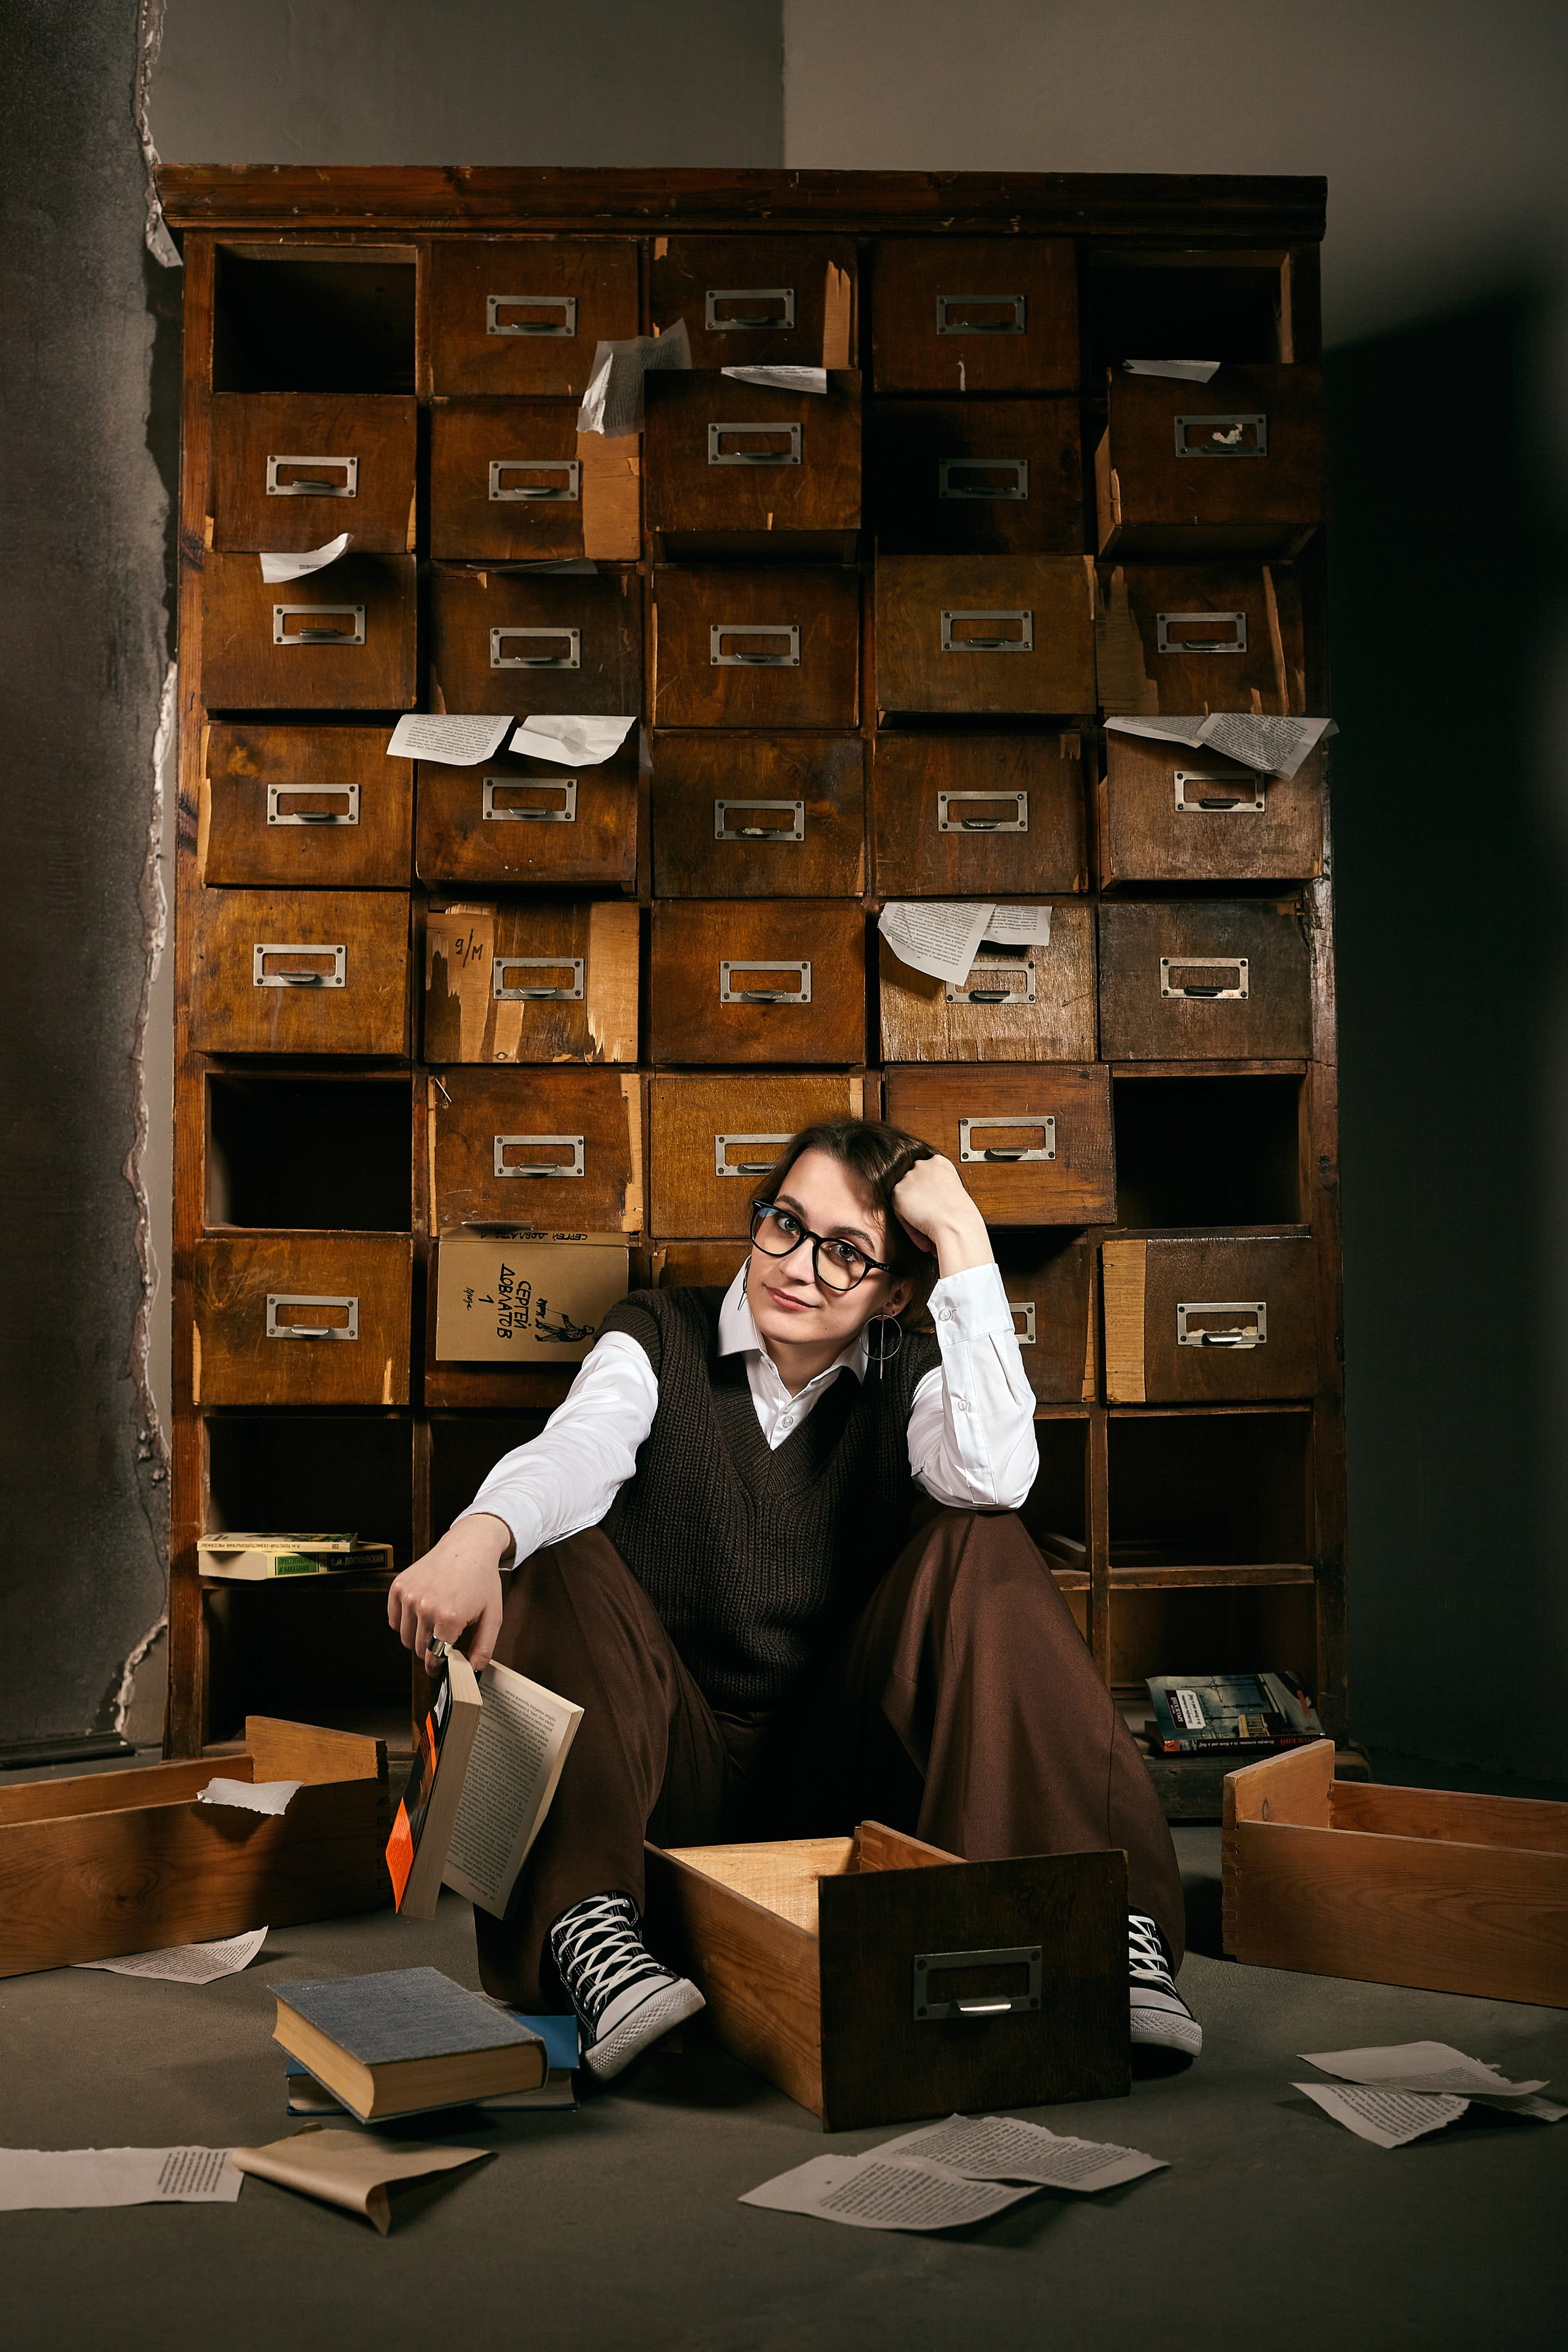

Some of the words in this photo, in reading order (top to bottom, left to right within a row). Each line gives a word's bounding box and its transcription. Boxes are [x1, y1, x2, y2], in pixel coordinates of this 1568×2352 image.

[552, 1233, 588, 1242] СЕРГЕЙ
[478, 1294, 495, 1304] 1
[496, 1263, 516, 1340] ДОВЛАТОВ
[513, 1280, 532, 1330] СЕРГЕЙ
[344, 1553, 384, 1566] ДОСТОЕВСКИЙ
[284, 1564, 310, 1573] НАКАЗАНИЕ
[1170, 1697, 1184, 1725] БРОДСКИЙ
